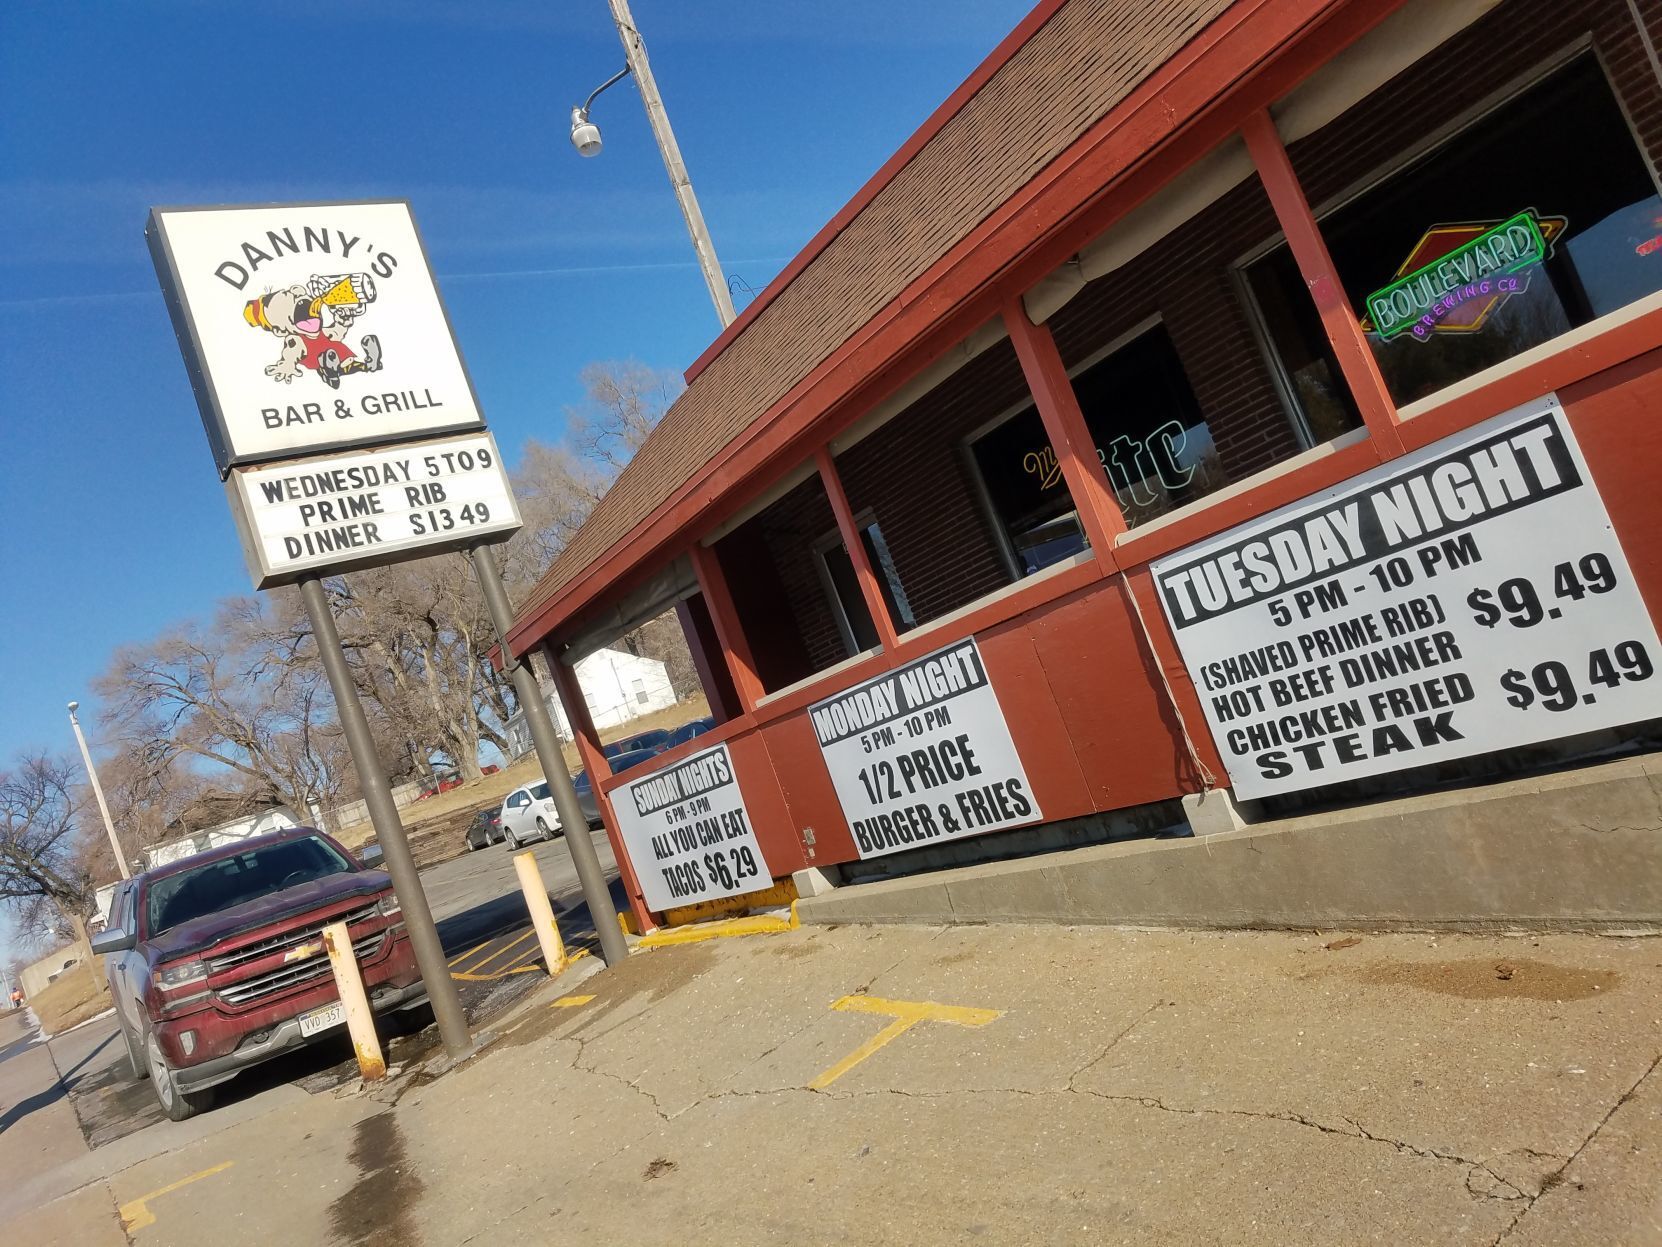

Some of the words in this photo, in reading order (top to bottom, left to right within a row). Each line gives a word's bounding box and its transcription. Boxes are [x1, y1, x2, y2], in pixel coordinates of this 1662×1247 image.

[214, 226, 398, 291] DANNY'S
[1372, 225, 1533, 329] BOULEVARD
[1413, 280, 1492, 336] BREWING
[261, 402, 324, 430] BAR
[335, 399, 354, 420] &
[361, 388, 442, 416] GRILL
[260, 460, 410, 504] WEDNESDAY
[299, 492, 384, 527] PRIME
[404, 482, 447, 508] RIB
[284, 521, 383, 559] DINNER
[1163, 502, 1367, 621] TUESDAY
[1371, 423, 1562, 547] NIGHT
[1268, 599, 1293, 627] 5
[1294, 579, 1349, 620] PM
[1369, 556, 1414, 593] 10
[1417, 532, 1483, 578] PM
[1466, 552, 1617, 629] $9.49
[1200, 640, 1299, 692] (SHAVED
[1297, 613, 1382, 663] PRIME
[1380, 594, 1446, 638] RIB)
[1211, 684, 1266, 723] HOT
[1268, 665, 1335, 708] BEEF
[1338, 631, 1463, 689] DINNER
[1500, 640, 1654, 712] $9.49
[812, 679, 900, 743] MONDAY
[899, 645, 979, 709] NIGHT
[1226, 699, 1367, 756] CHICKEN
[1368, 672, 1475, 723] FRIED
[860, 735, 872, 754] 5
[873, 726, 896, 750] PM
[903, 716, 923, 738] 10
[924, 705, 952, 731] PM
[1255, 710, 1466, 780] STEAK
[633, 772, 682, 813] SUNDAY
[678, 752, 730, 795] NIGHTS
[858, 760, 902, 805] 1/2
[896, 733, 982, 794] PRICE
[651, 833, 675, 860] ALL
[670, 823, 699, 854] YOU
[695, 816, 724, 847] CAN
[720, 808, 748, 839] EAT
[665, 811, 672, 824] 6
[673, 805, 687, 822] PM
[691, 803, 698, 817] 9
[698, 796, 712, 814] PM
[852, 803, 940, 853] BURGER
[938, 803, 962, 833] &
[955, 777, 1032, 829] FRIES
[662, 859, 707, 898] TACOS
[703, 845, 758, 890] $6.29
